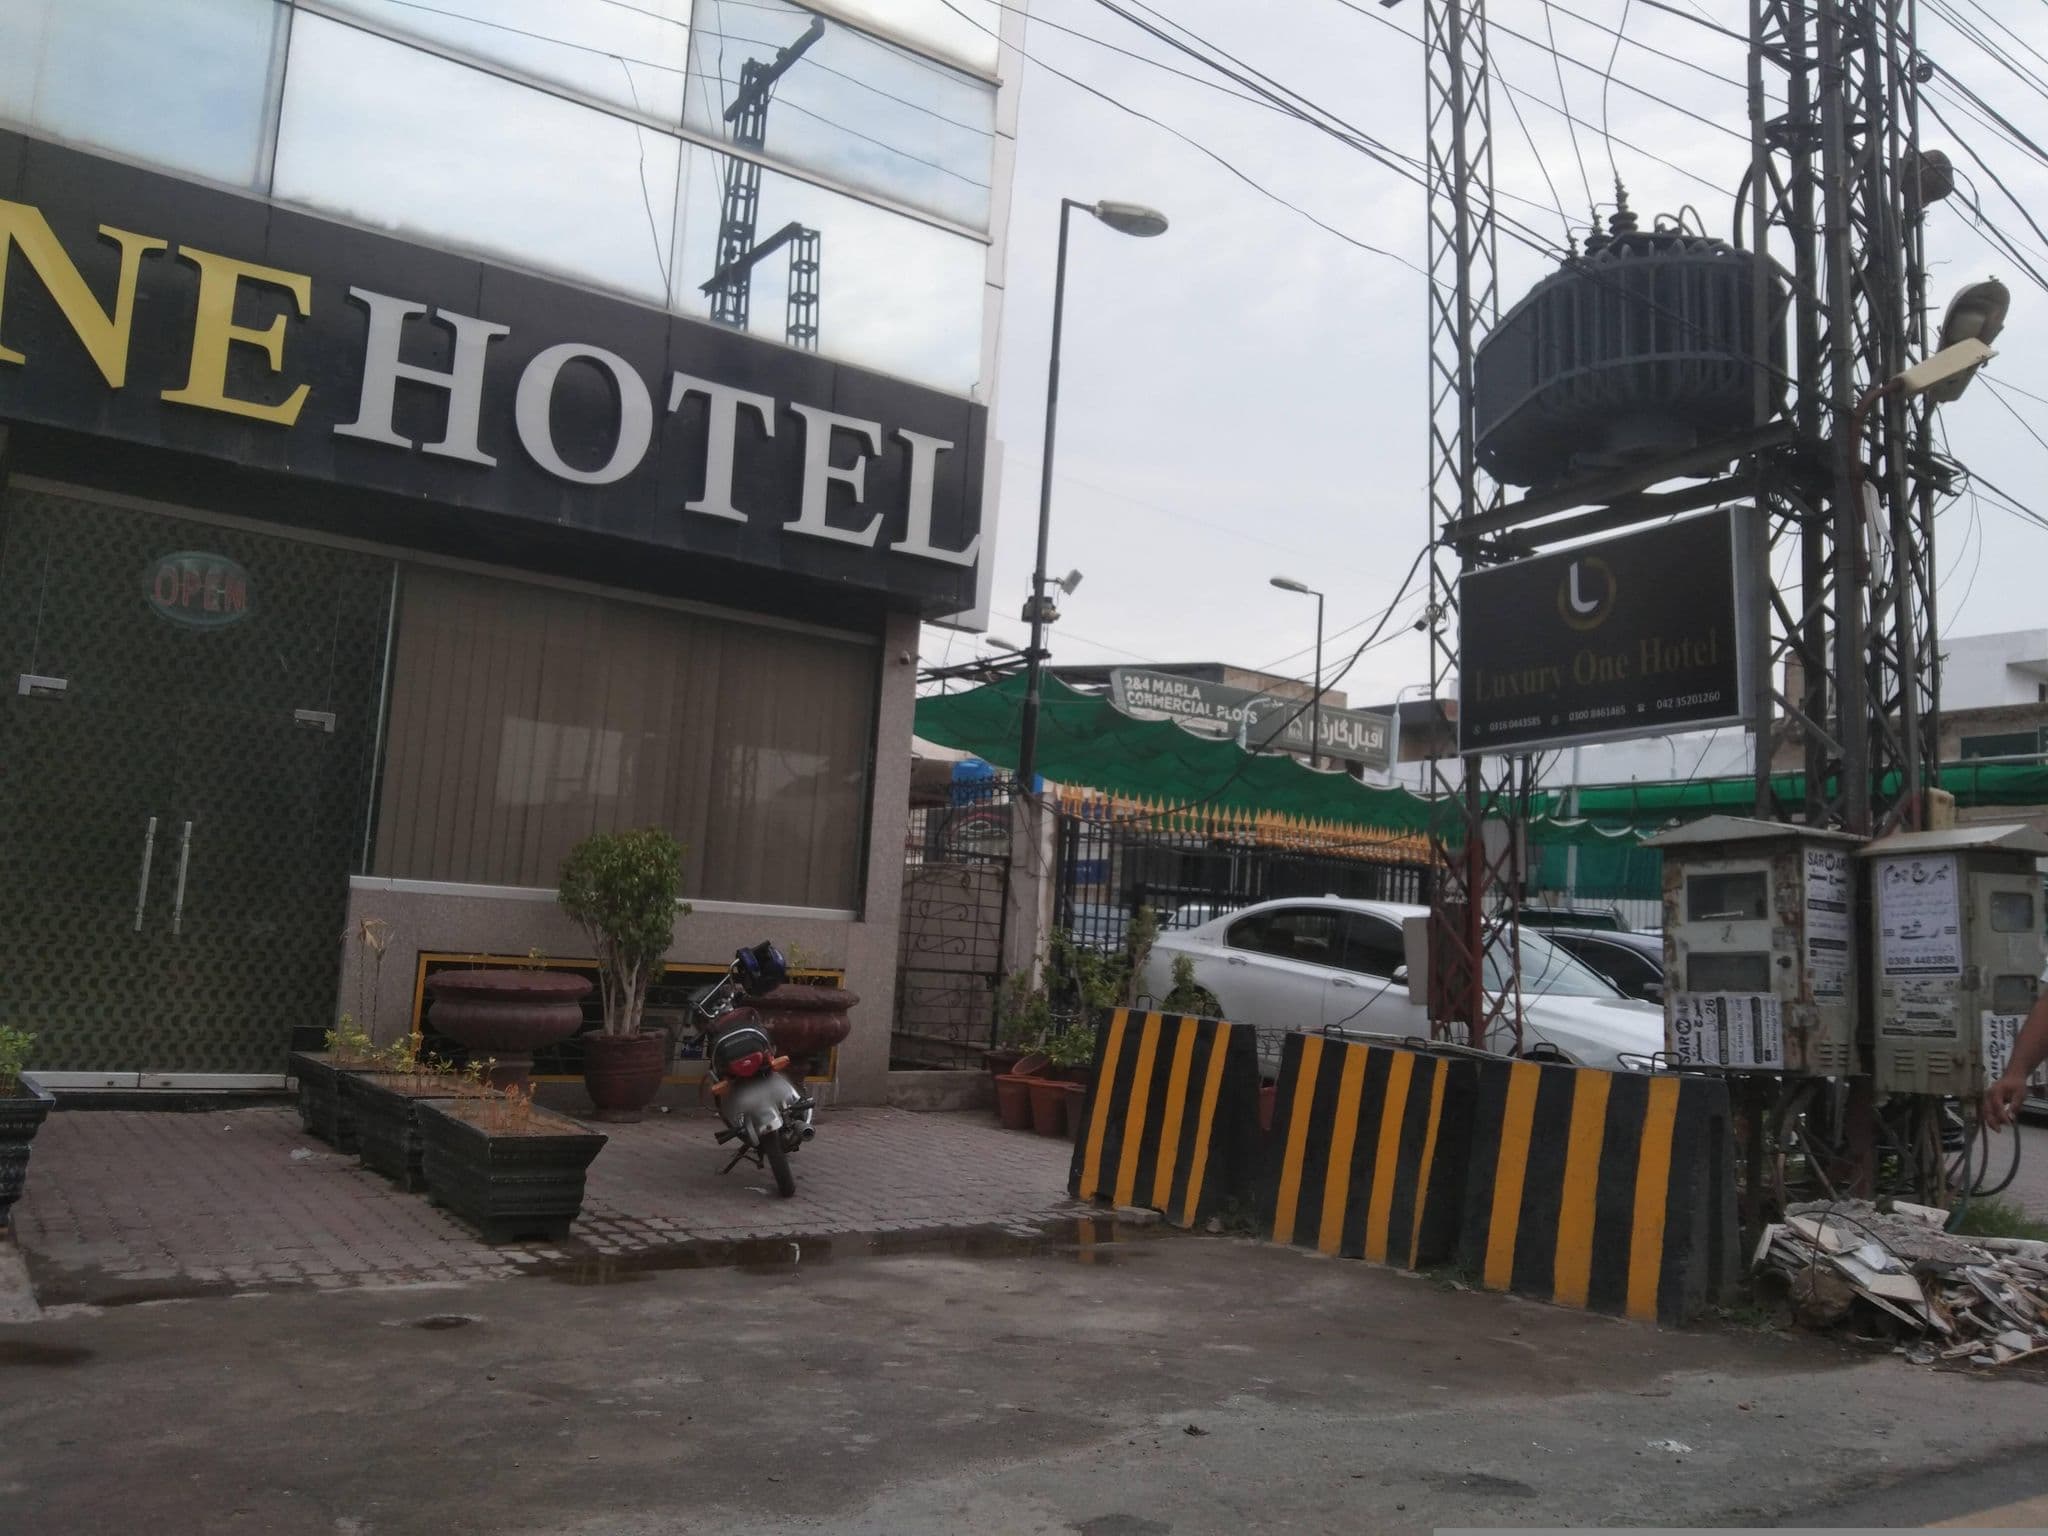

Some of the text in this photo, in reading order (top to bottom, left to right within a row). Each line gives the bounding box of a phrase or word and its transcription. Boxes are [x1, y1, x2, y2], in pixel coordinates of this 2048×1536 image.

[333, 285, 981, 567] HOTEL
[154, 564, 246, 612] OPEN
[1475, 627, 1717, 700] Luxury One Hotel
[1124, 676, 1201, 700] 2&4 MARLA
[1348, 722, 1384, 753] اقبال
